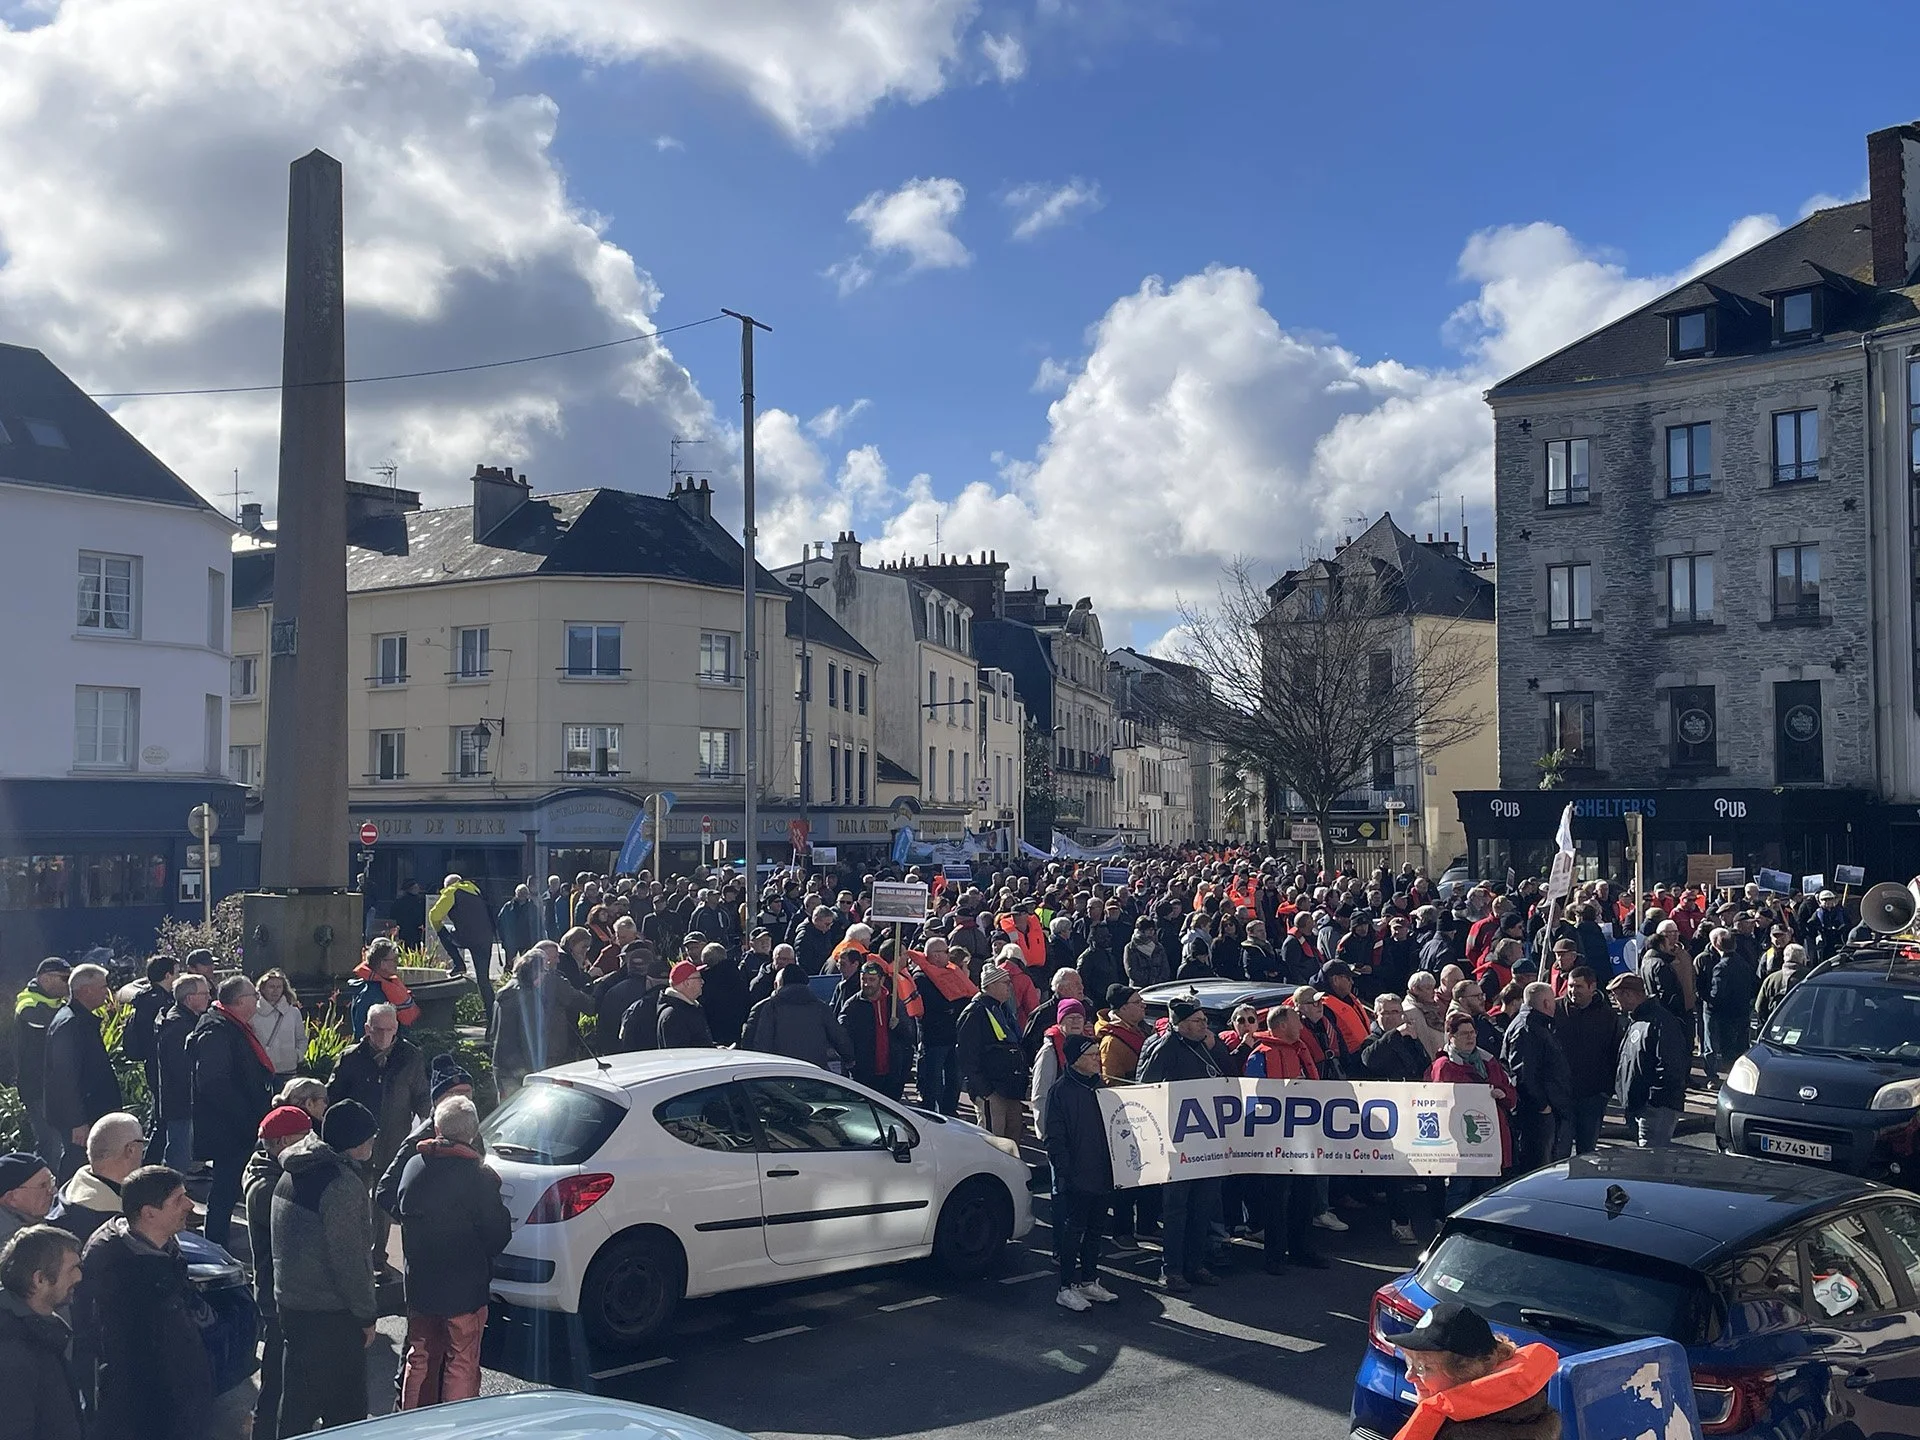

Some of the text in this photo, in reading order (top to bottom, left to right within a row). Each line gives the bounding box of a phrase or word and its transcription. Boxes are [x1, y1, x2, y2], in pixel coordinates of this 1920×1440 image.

[1490, 799, 1521, 818] PUB
[1574, 798, 1657, 818] SHELTER'S
[1714, 798, 1747, 818] PUB
[424, 818, 445, 835] DE
[665, 817, 818, 834] BILLRDS POL
[1411, 1099, 1436, 1107] FNPP
[1173, 1095, 1399, 1144] APPPCO
[1180, 1152, 1224, 1165] Association
[1228, 1146, 1264, 1160] Paisanciers
[1265, 1150, 1273, 1159] et
[1316, 1147, 1333, 1160] Pied
[1334, 1150, 1343, 1160] de
[1344, 1150, 1351, 1160] la
[1353, 1148, 1370, 1160] Côte
[1372, 1148, 1395, 1161] Ouest
[1768, 1139, 1824, 1158] FX-749-YL
